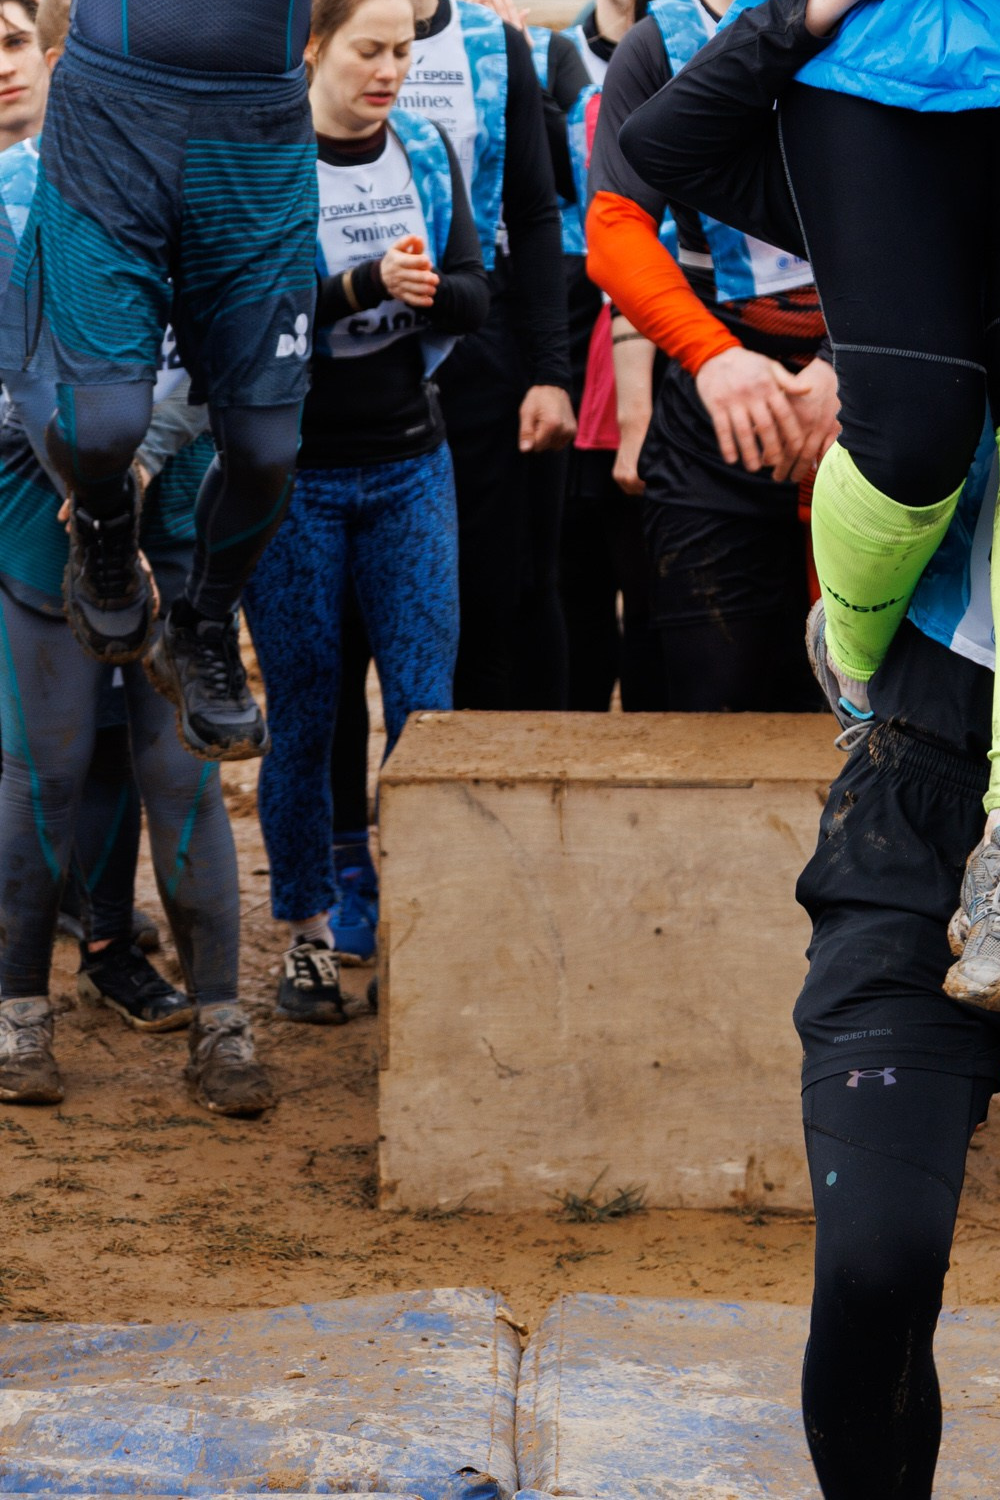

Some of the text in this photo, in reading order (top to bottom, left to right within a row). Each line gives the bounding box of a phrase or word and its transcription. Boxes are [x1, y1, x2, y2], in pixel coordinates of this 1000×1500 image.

[415, 70, 465, 81] ГЕРОЕВ
[320, 194, 414, 217] ГОНКА ГЕРОЕВ
[342, 221, 411, 244] Sminex
[833, 1027, 893, 1043] PROJECT ROCK
